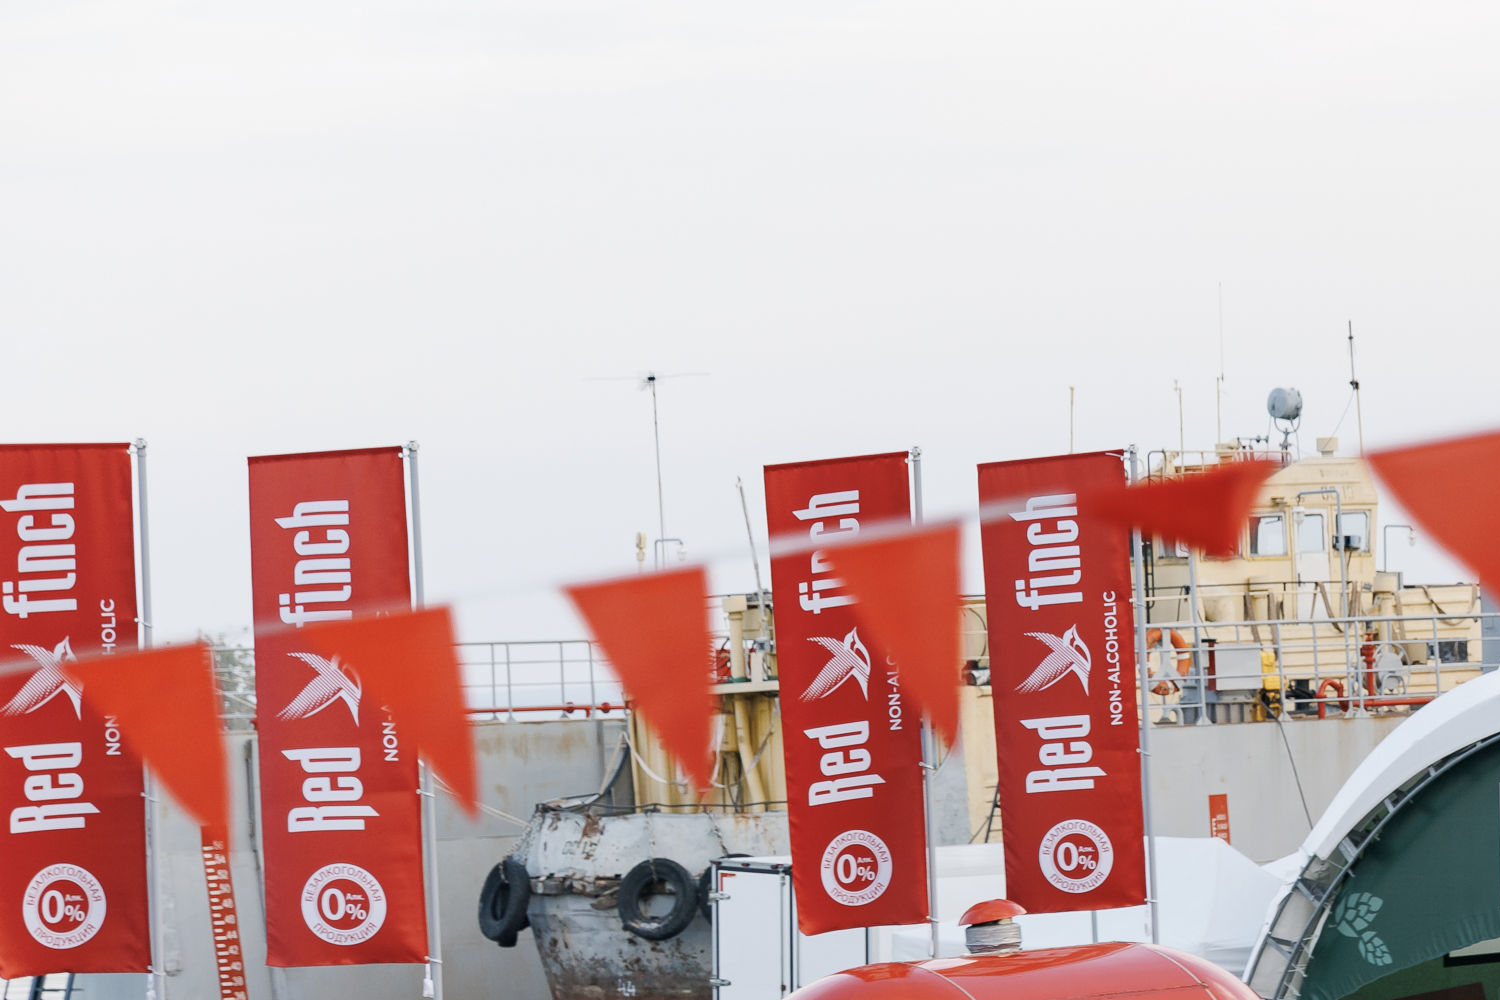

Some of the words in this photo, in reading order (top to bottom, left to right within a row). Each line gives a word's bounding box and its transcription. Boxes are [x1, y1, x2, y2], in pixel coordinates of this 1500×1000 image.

[0, 482, 77, 618] finch
[274, 500, 352, 628] finch
[1008, 493, 1083, 610] finch
[1103, 590, 1123, 726] NON-ALCOHOLIC
[3, 742, 101, 834] Red
[281, 747, 380, 833] Red
[803, 720, 886, 807] Red
[1020, 714, 1107, 794] Red
[1042, 822, 1110, 855] БЕЗАЛКОГОЛЬНАЯ
[1050, 871, 1105, 892] ПРОДУКЦИЯ
[305, 866, 382, 902] БЕЗАЛКОГОЛЬНАЯ
[34, 924, 96, 947] ПРОДУКЦИЯ
[314, 922, 377, 943] ПРОДУКЦИЯ
